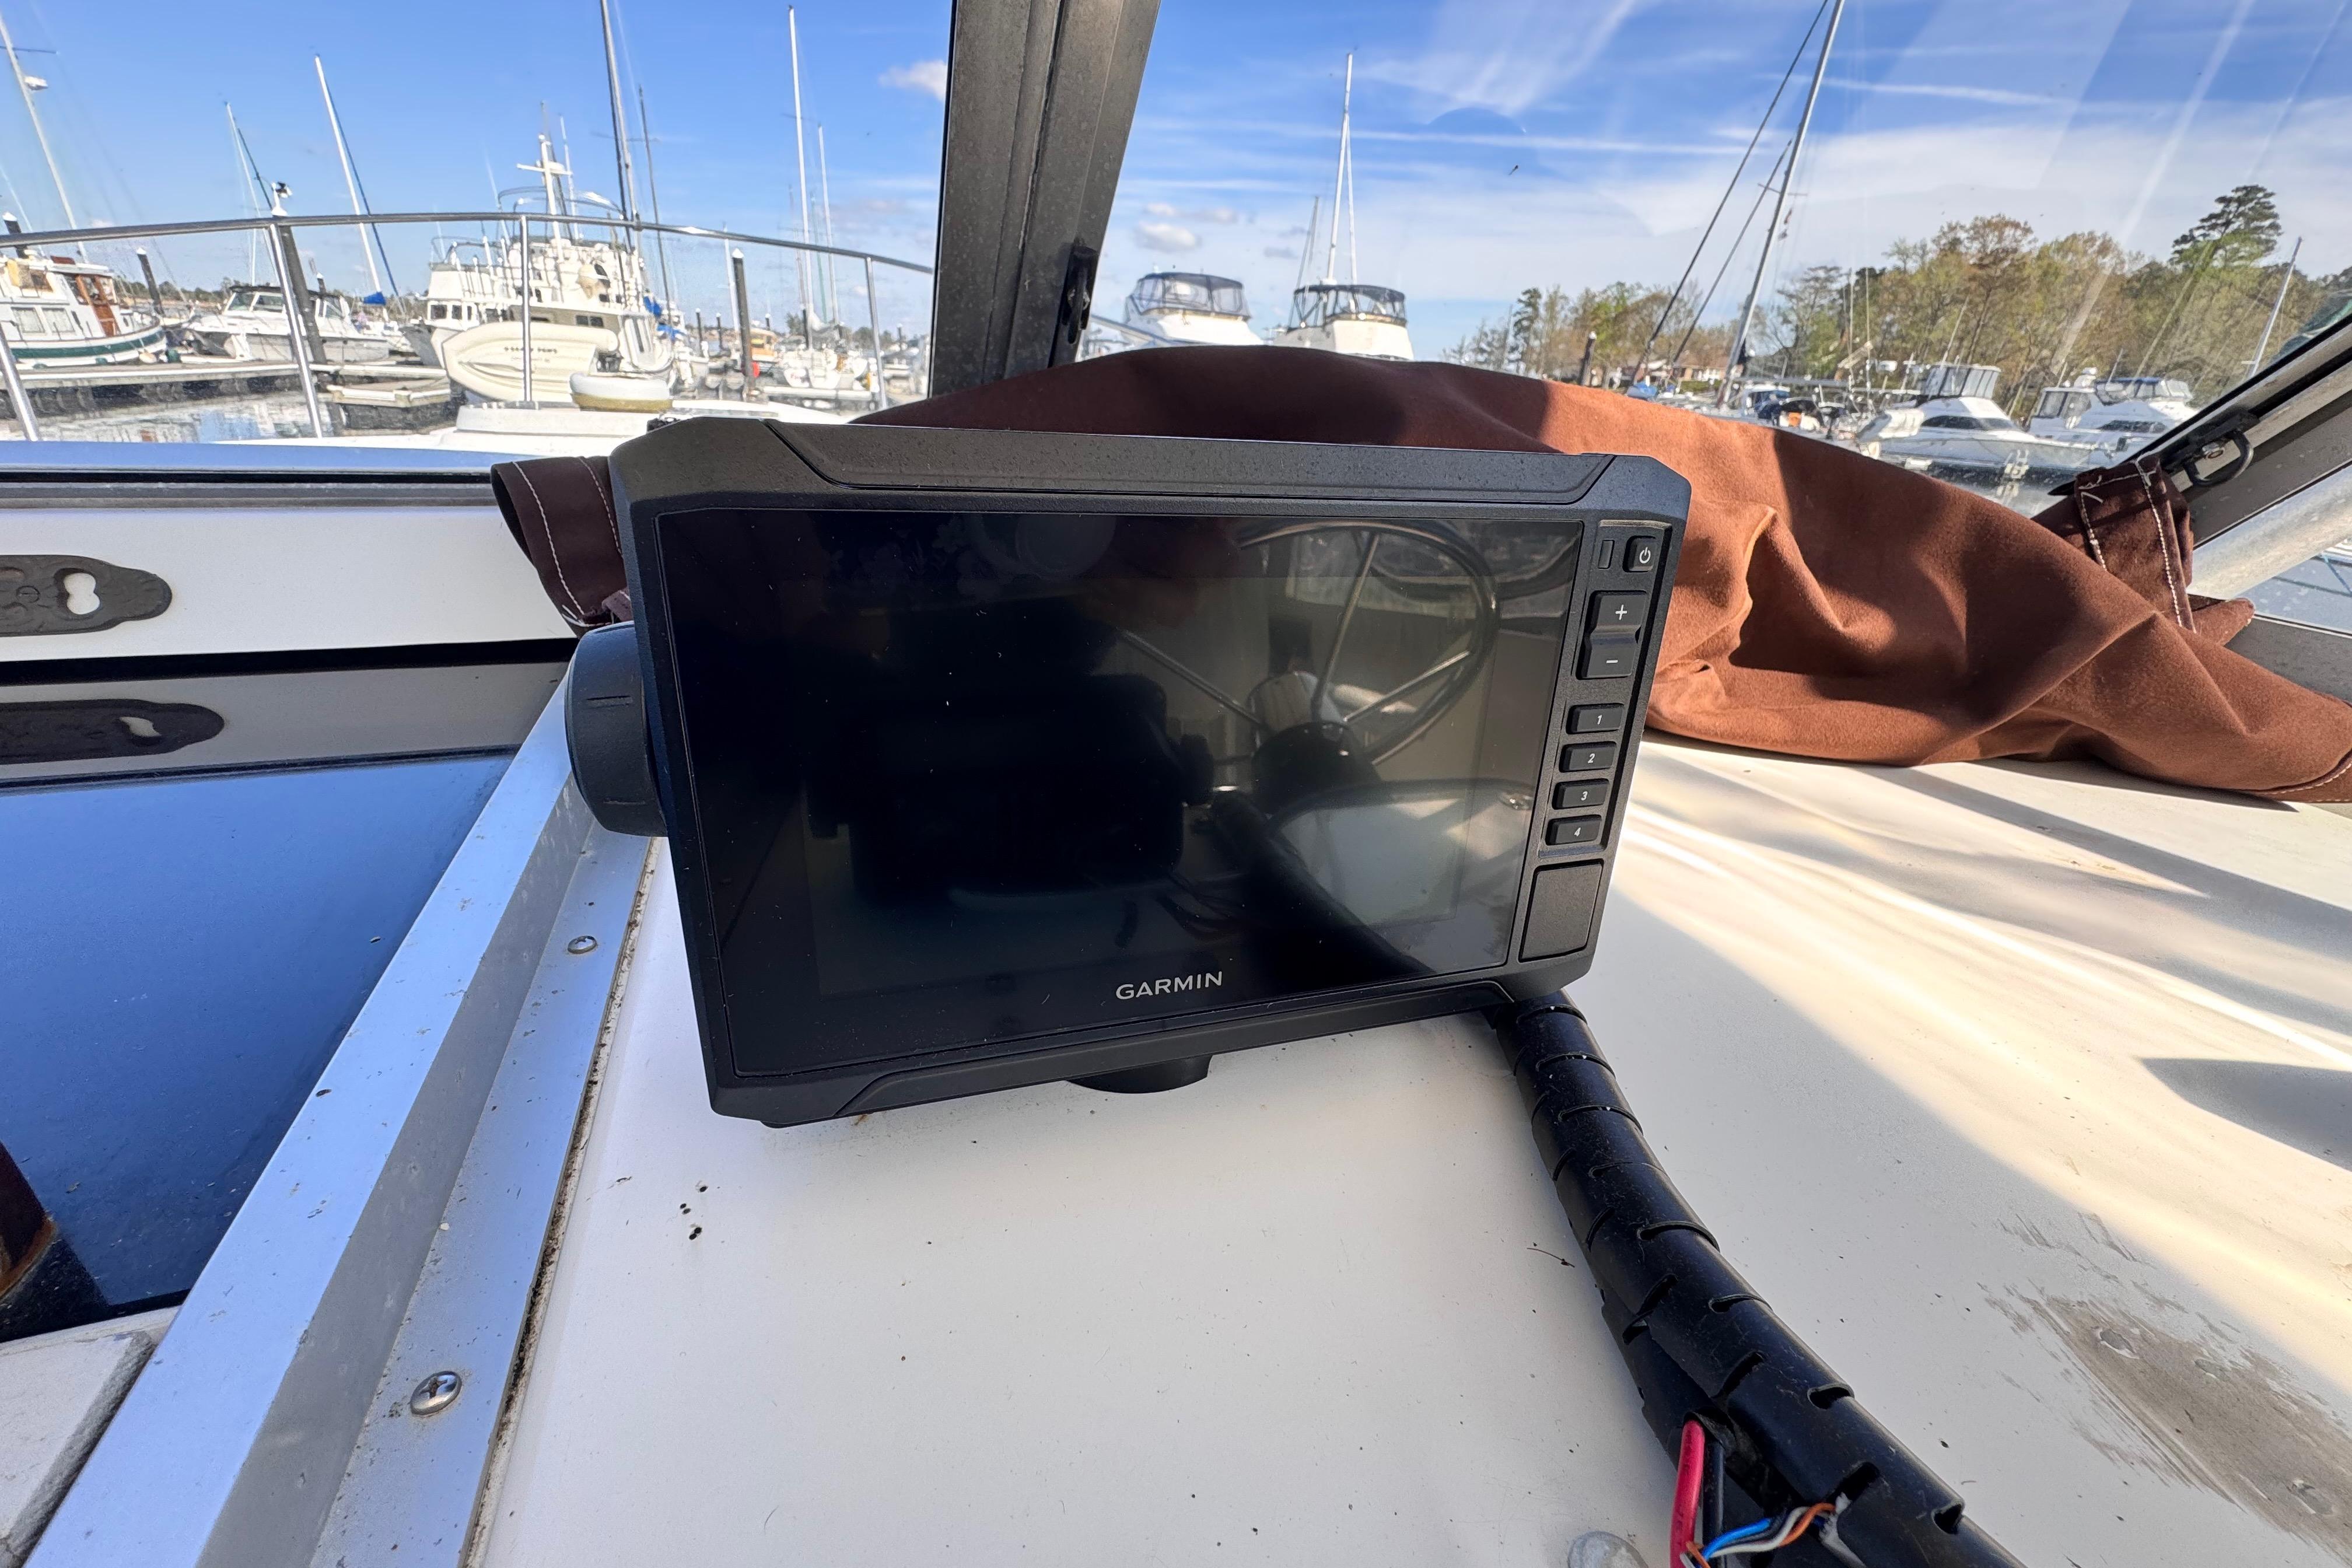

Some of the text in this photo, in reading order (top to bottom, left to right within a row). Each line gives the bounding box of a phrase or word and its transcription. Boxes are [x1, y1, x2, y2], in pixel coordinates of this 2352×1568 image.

[1597, 715, 1602, 725] 1
[1587, 753, 1595, 764] 2
[1581, 791, 1588, 801] 3
[1574, 827, 1581, 837] 4
[1115, 971, 1223, 1000] GARMIN
